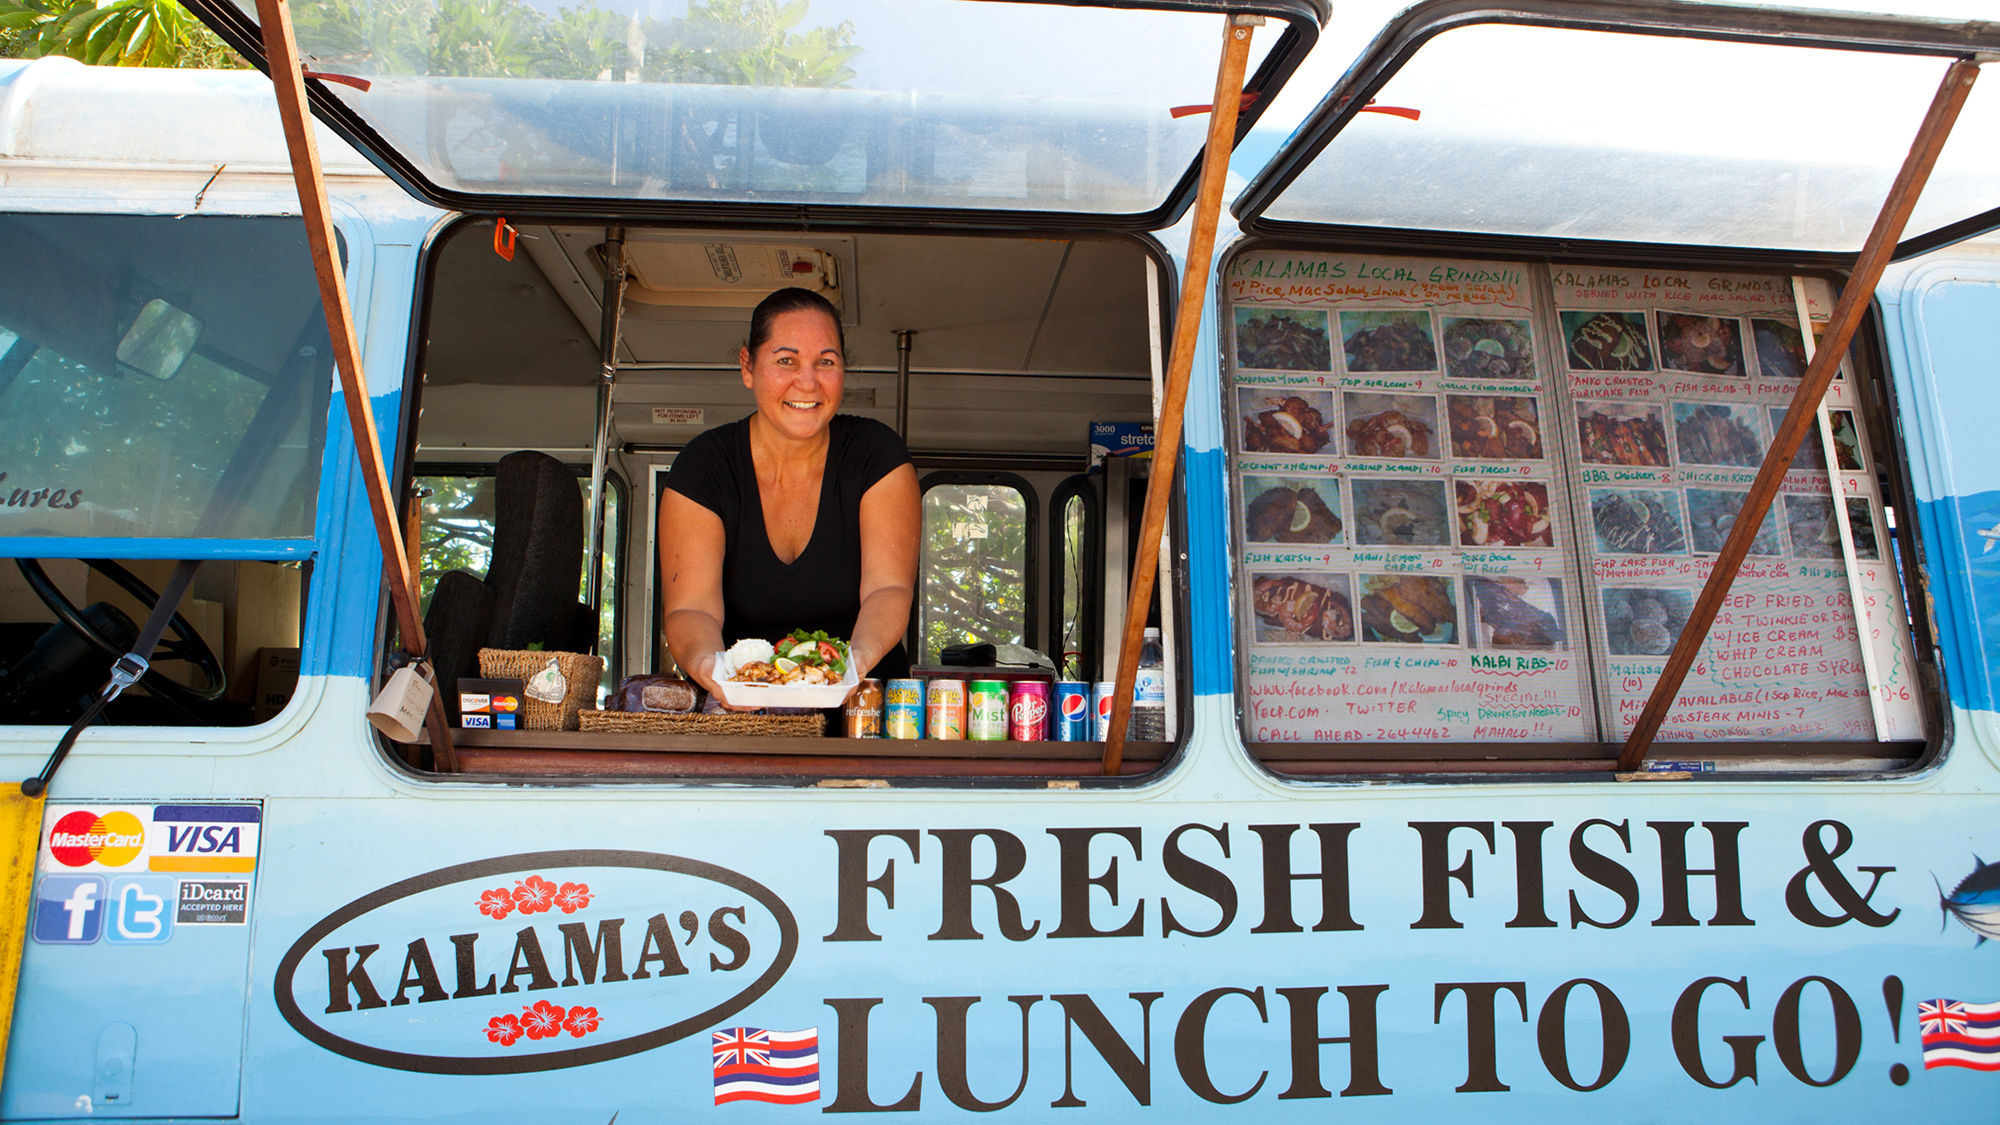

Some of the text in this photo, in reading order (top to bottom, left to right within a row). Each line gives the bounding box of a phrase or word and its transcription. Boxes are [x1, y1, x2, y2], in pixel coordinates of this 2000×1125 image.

[1232, 257, 1346, 278] KALAMAS
[1358, 262, 1417, 281] LOCAL
[1643, 274, 1692, 289] LOCAL
[1289, 286, 1321, 297] Mac
[1576, 288, 1766, 303] SERVED WITH RICE MAC SALAD
[1339, 378, 1361, 386] TOP
[1568, 374, 1601, 387] PANKO
[1629, 388, 1649, 397] FISH
[1674, 382, 1698, 393] FISH
[1757, 383, 1780, 394] FISH
[1095, 425, 1116, 433] 3000
[1121, 433, 1156, 446] stretc
[1344, 463, 1382, 471] SHRIMP
[1453, 465, 1476, 474] FISH
[1480, 465, 1510, 474] TACOS
[1245, 553, 1270, 564] FISH
[1275, 553, 1312, 563] KATSU
[1481, 564, 1509, 573] RICE
[1800, 566, 1820, 577] AHI
[1723, 593, 1756, 608] EEP
[1766, 593, 1815, 609] FRIED
[1741, 612, 1807, 627] TWINKIE
[1812, 612, 1829, 624] OR
[1737, 630, 1761, 644] ICE
[1767, 629, 1820, 643] CREAM
[1716, 646, 1824, 661] WHIP CREAM
[1364, 656, 1391, 668] FISH
[1471, 655, 1511, 668] KALBI
[1250, 666, 1276, 676] FISH
[1722, 659, 1866, 680] CHOCOLATE SYRU
[1623, 676, 1643, 693] (10)
[887, 687, 919, 699] ALOHA
[929, 687, 960, 699] ALOHA
[1826, 688, 1849, 699] Mac
[1014, 703, 1045, 722] Pepper
[1345, 700, 1417, 715] TWITTER
[464, 717, 489, 726] VISA
[973, 708, 1005, 722] Mist
[1687, 711, 1731, 722] STEAK
[1736, 709, 1780, 722] MINIS
[1258, 726, 1302, 741] CALL
[51, 832, 143, 849] MasterCard
[168, 825, 241, 853] VISA
[822, 818, 1901, 942] FRESH FISH &
[182, 883, 245, 901] iDcard
[180, 903, 244, 912] ACCEPTED HERE
[822, 983, 1394, 1114] LUNCH
[1434, 977, 1631, 1093] TO
